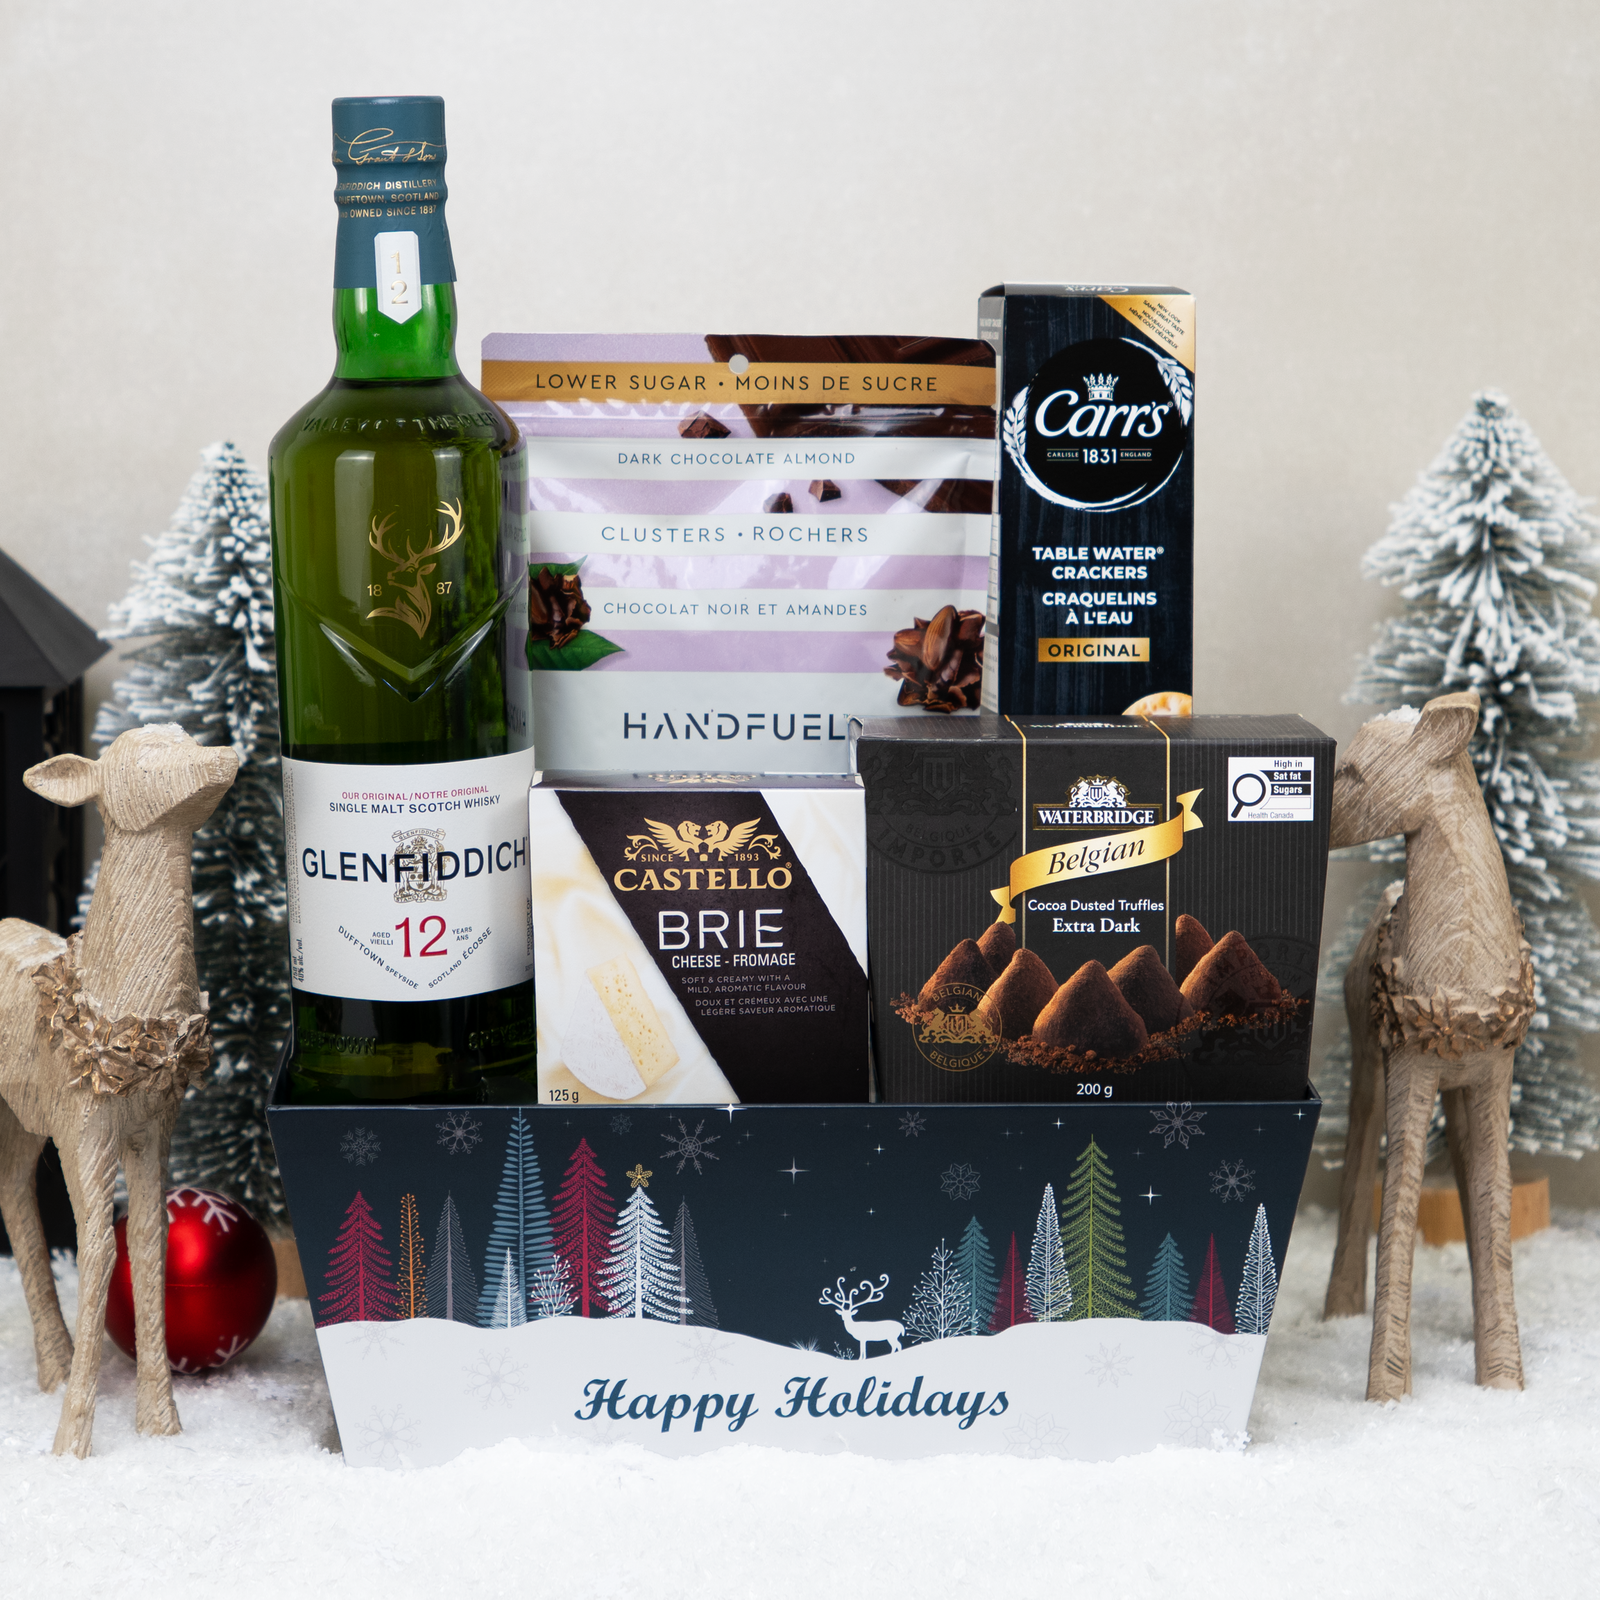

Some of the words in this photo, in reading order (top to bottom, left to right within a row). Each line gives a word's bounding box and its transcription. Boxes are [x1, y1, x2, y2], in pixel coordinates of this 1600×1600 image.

[385, 179, 437, 190] DISTILLERY
[391, 192, 439, 203] SCOTLAND
[350, 208, 383, 218] OWNED
[386, 206, 417, 217] SINCE
[419, 205, 437, 215] 1887
[1143, 299, 1156, 310] SAME
[1155, 310, 1171, 323] GREAT
[1170, 322, 1185, 335] TASTE
[1157, 302, 1168, 312] NEW
[1168, 311, 1182, 324] LOOK
[1142, 310, 1163, 328] NOUVEAU
[1162, 326, 1175, 338] LOOK
[535, 373, 618, 391] LOWER
[629, 374, 707, 391] SUGAR
[735, 375, 810, 391] MOINS
[822, 376, 850, 391] DE
[862, 376, 938, 392] SUCRE
[617, 452, 662, 465] DARK
[670, 452, 775, 465] CHOCOLATE
[783, 452, 855, 465] ALMOND
[1083, 449, 1117, 464] 1831
[601, 526, 726, 543] CLUSTERS
[752, 525, 869, 543] ROCHERS
[1032, 547, 1089, 560] TABLE
[1052, 566, 1148, 579] CRACKERS
[367, 584, 382, 597] 18
[436, 582, 452, 595] 87
[1042, 592, 1157, 607] CRAQUELINS
[603, 602, 699, 616] CHOCOLAT
[707, 603, 750, 616] NOIR
[758, 603, 777, 616] ET
[786, 603, 868, 617] AMANDES
[1065, 608, 1079, 624] À
[1084, 611, 1133, 624] L'EAU
[1048, 644, 1140, 657] ORIGINAL
[1274, 759, 1292, 769] High
[1295, 760, 1303, 768] in
[1273, 771, 1287, 780] Sat
[1289, 771, 1302, 780] fat
[342, 792, 359, 800] OUR
[451, 785, 489, 797] ORIGINAL
[1273, 785, 1303, 795] Sugars
[329, 802, 368, 813] SINGLE
[371, 804, 404, 814] MALT
[409, 801, 461, 813] SCOTCH
[464, 794, 501, 809] WHISKY
[1037, 809, 1155, 825] WATERBRIDGE
[1247, 811, 1268, 819] Health
[1270, 811, 1294, 819] Canada
[302, 837, 527, 884] GLENFIDDICH
[641, 853, 674, 862] SINCE
[734, 853, 759, 862] 1893
[1047, 838, 1145, 876] Belgian
[613, 868, 793, 892] CASTELLO
[1028, 900, 1067, 911] Cocoa
[1070, 899, 1115, 911] Dusted
[1118, 899, 1164, 911] Truffles
[452, 926, 472, 935] YEARS
[658, 909, 784, 950] BRIE
[1052, 918, 1095, 933] Extra
[1099, 918, 1140, 933] Dark
[370, 938, 393, 946] VIEILLI
[395, 915, 448, 958] 12
[338, 925, 385, 967] DUFFTOWN
[385, 965, 419, 990] SPEYSIDE
[672, 954, 721, 969] CHEESE
[733, 952, 796, 968] FROMAGE
[428, 959, 462, 989] SCOTLAND
[681, 976, 706, 984] SOFT
[708, 976, 714, 984] &
[717, 976, 755, 984] CREAMY
[758, 975, 782, 983] WITH
[783, 974, 791, 982] A
[687, 985, 712, 994] MILD,
[714, 984, 762, 993] AROMATIC
[764, 983, 806, 992] FLAVOUR
[932, 986, 983, 1001] BELGIAN
[695, 998, 721, 1007] DOUX
[724, 998, 735, 1006] ET
[738, 995, 781, 1006] CRÉMEUX
[783, 996, 808, 1004] AVEC
[810, 995, 828, 1003] UNE
[701, 1005, 736, 1016] LÉGÈRE
[738, 1006, 775, 1015] SAVEUR
[777, 1003, 836, 1014] AROMATIQUE
[929, 1050, 985, 1068] BELGIQUE
[549, 1089, 568, 1102] 125
[572, 1092, 579, 1104] g
[1076, 1083, 1101, 1096] 200
[1104, 1086, 1113, 1098] g
[574, 1378, 758, 1433] Happy
[774, 1375, 1009, 1430] Holidays
